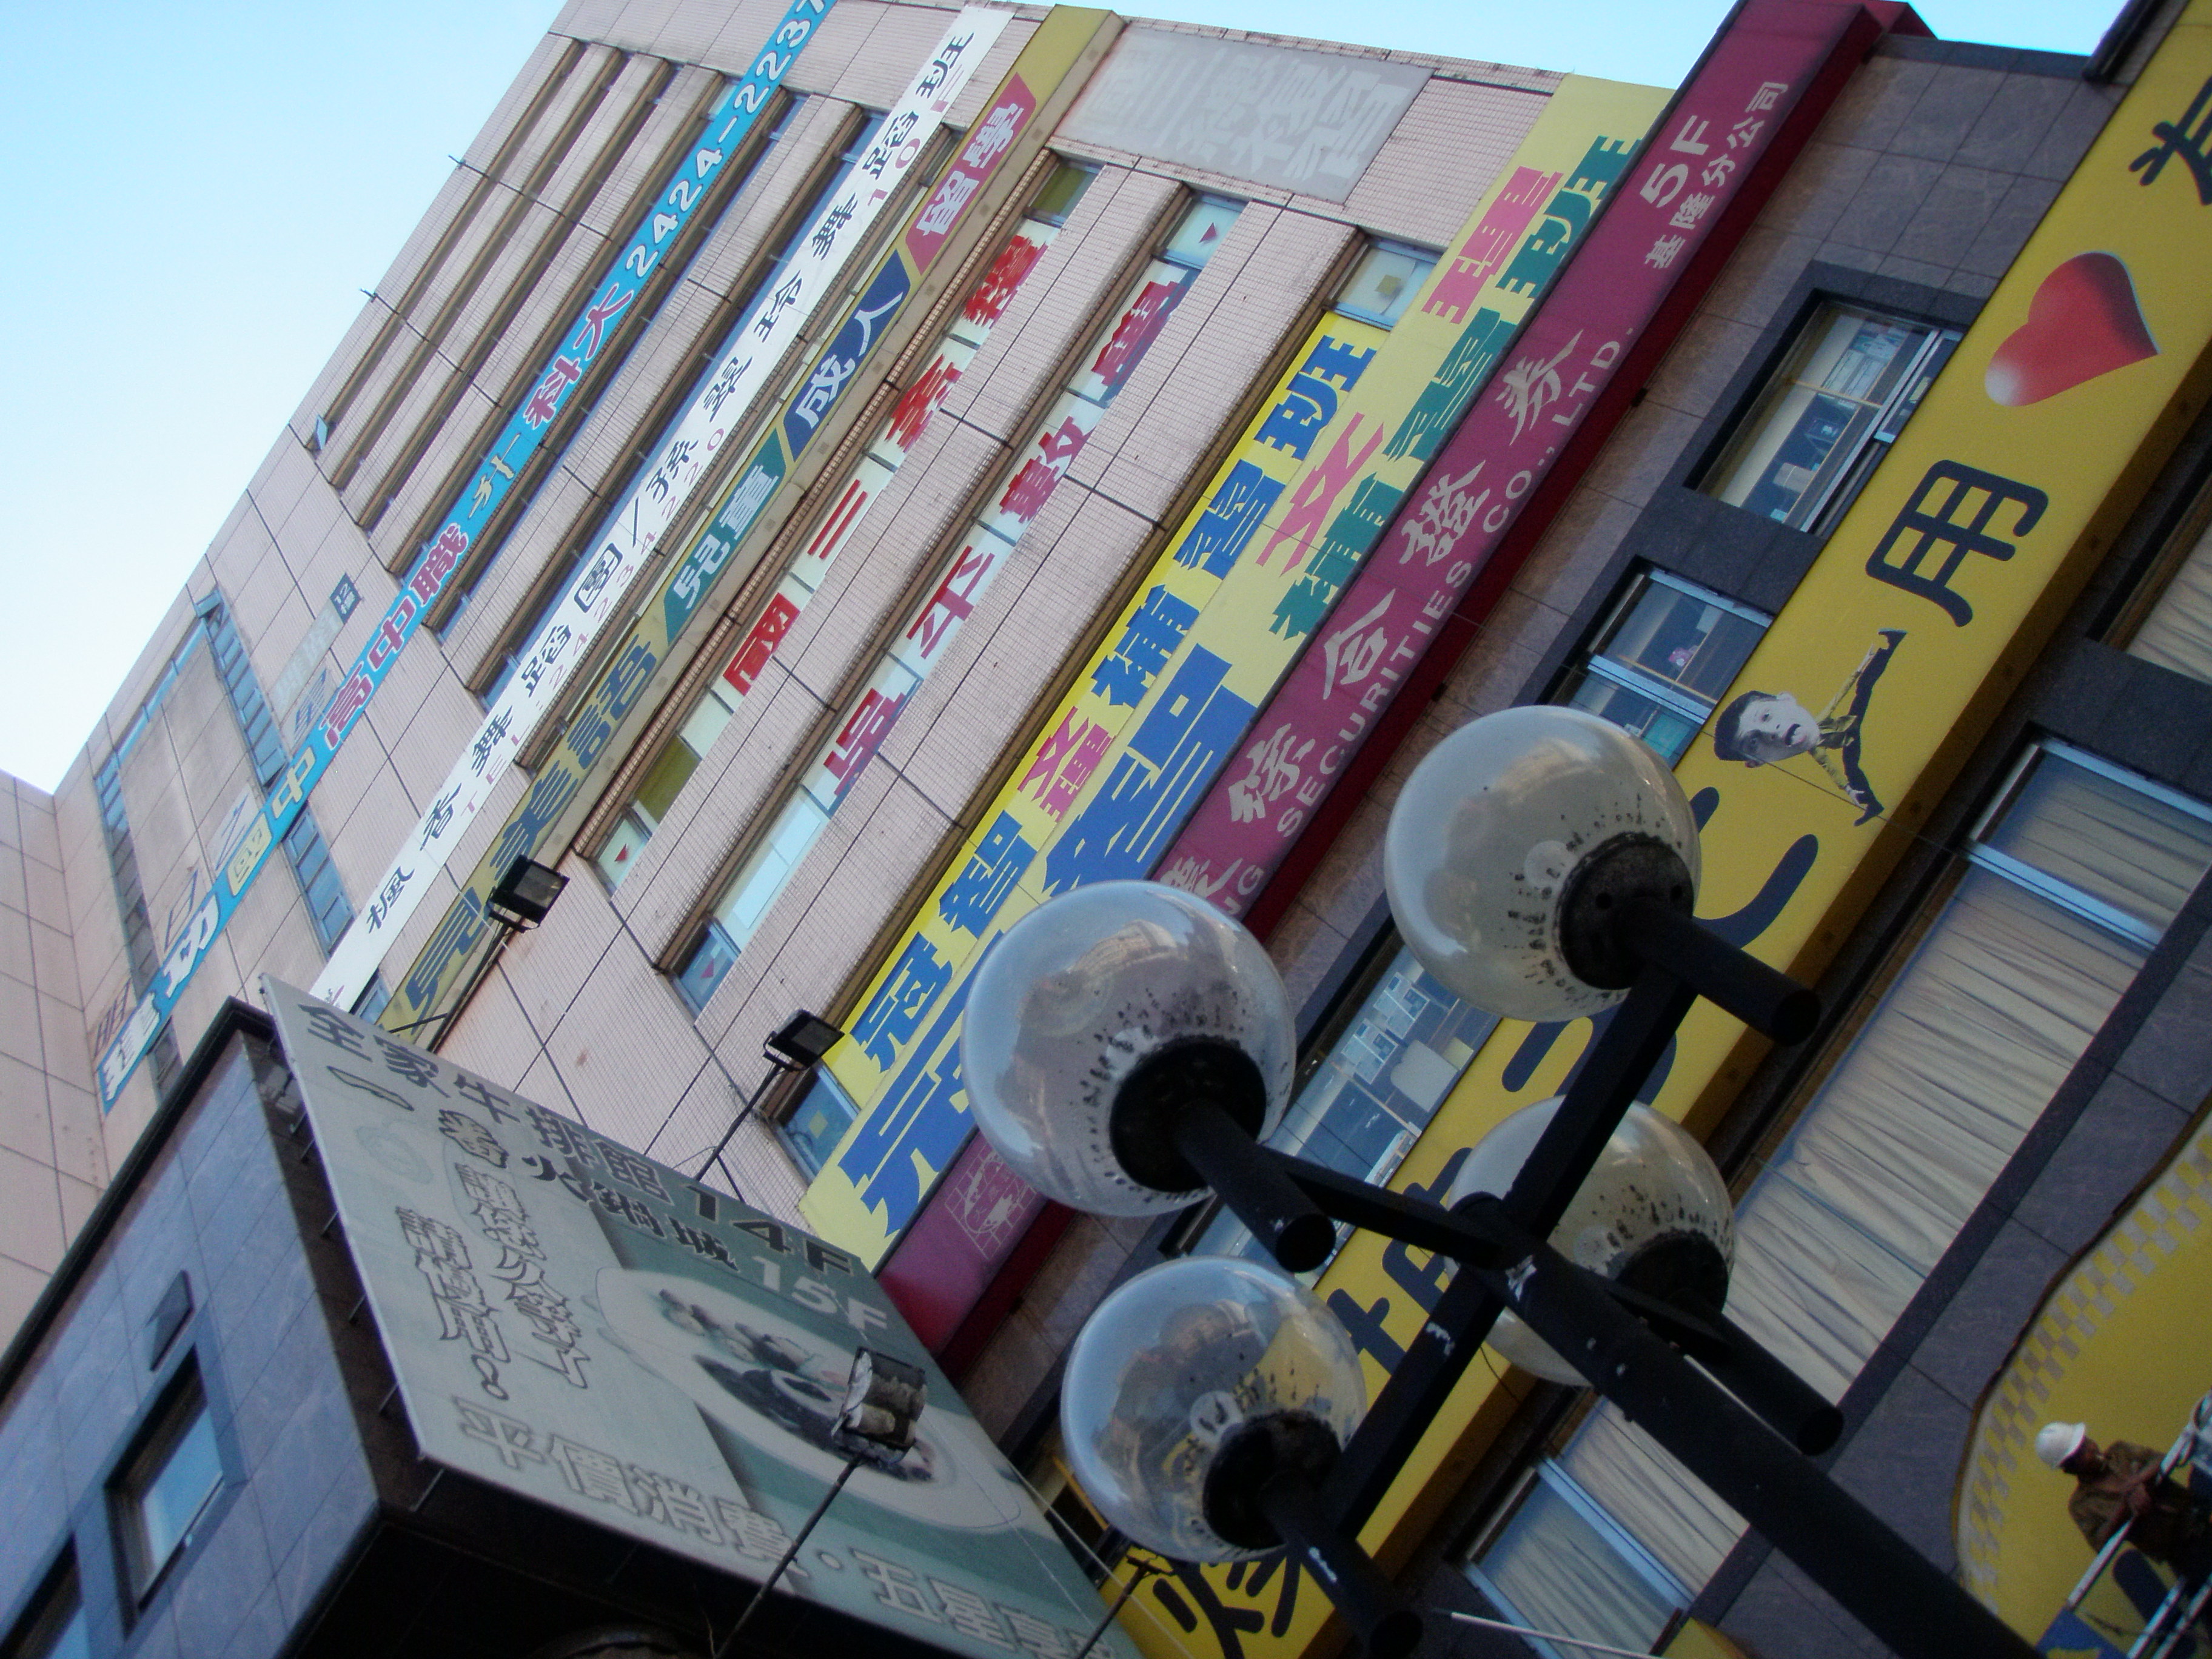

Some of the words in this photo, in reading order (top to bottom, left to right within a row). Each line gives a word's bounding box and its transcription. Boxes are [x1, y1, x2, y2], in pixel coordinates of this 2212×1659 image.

[867, 64, 965, 206] 10F
[1639, 115, 1710, 208] 5F
[1644, 81, 1789, 269] 基隆分公司
[673, 464, 779, 610] 兒童
[796, 291, 903, 429] 成人
[916, 102, 1025, 236] 留學
[1277, 560, 1472, 837] SECURITIES
[298, 1004, 674, 1205] 全家牛排館
[684, 1182, 854, 1276] 14F
[326, 1065, 739, 1272] 一番火鍋城
[752, 1255, 888, 1330] 15F
